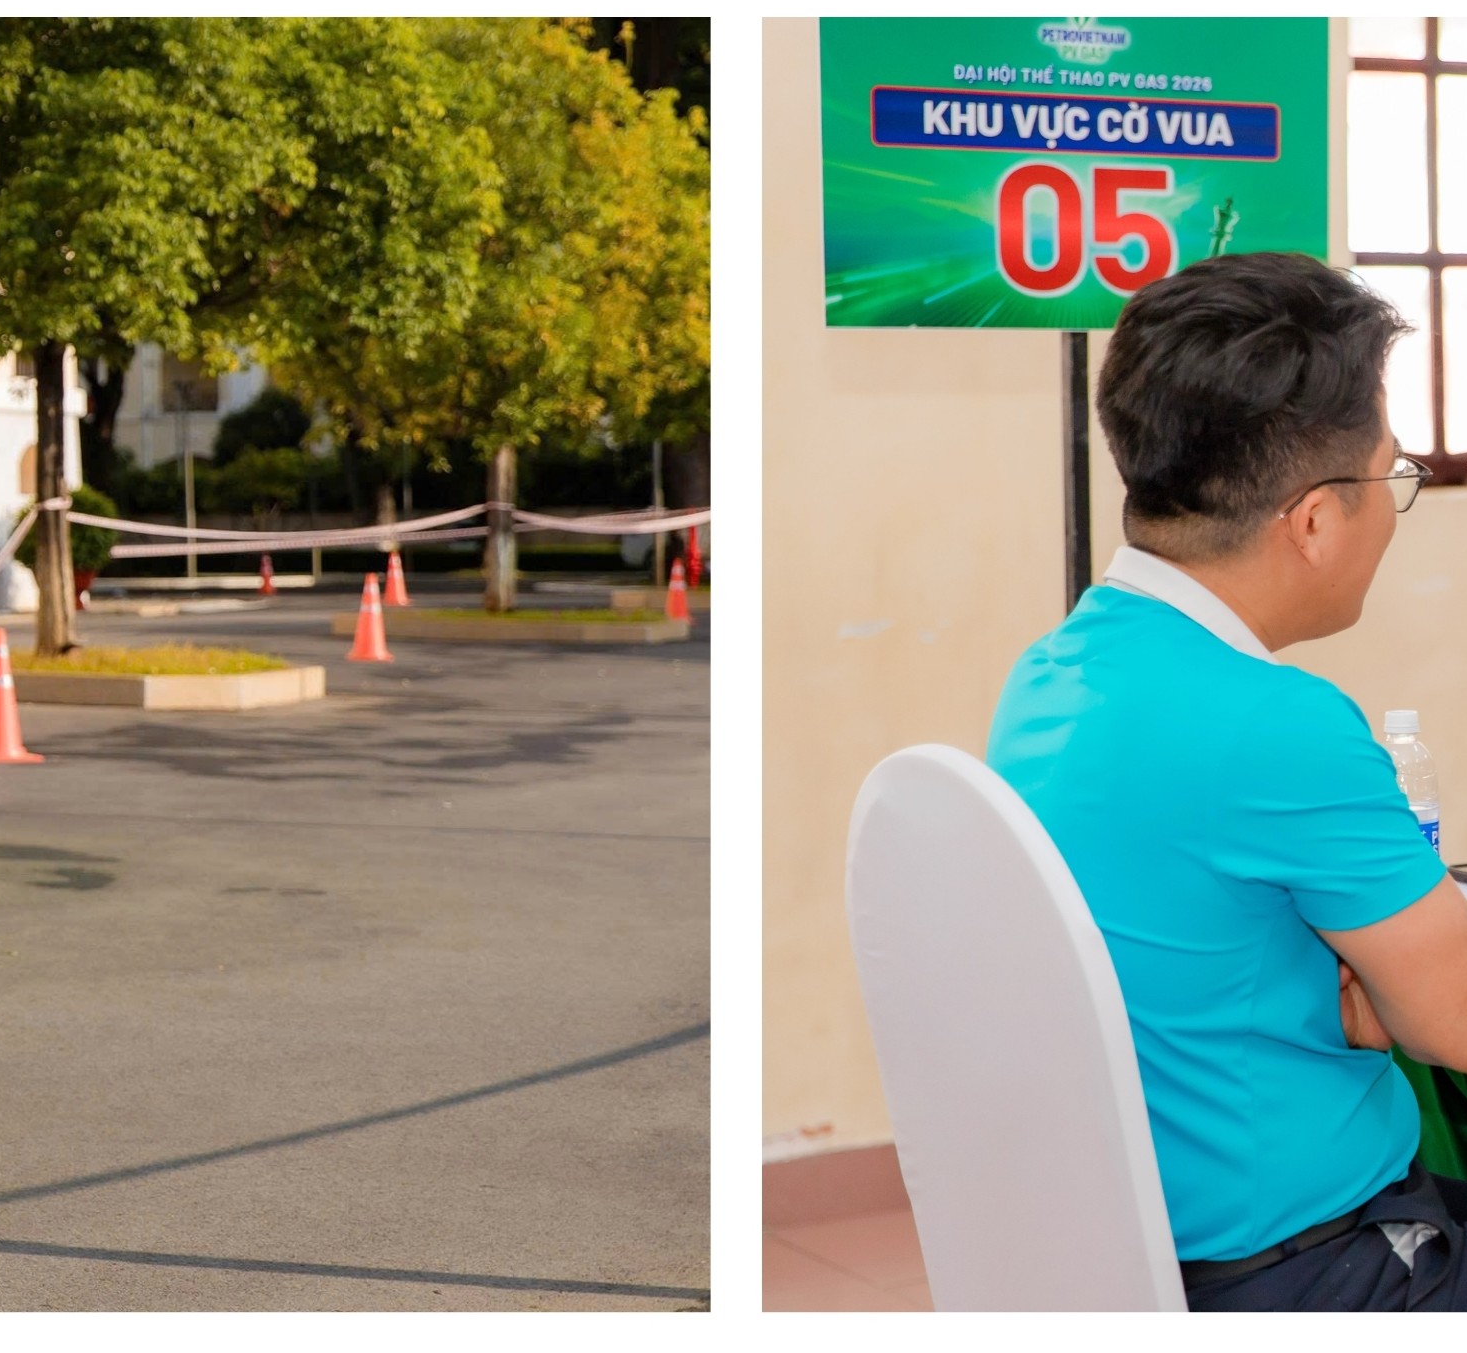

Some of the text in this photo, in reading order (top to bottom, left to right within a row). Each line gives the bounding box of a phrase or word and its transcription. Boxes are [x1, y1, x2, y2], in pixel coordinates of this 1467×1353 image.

[1040, 28, 1126, 44] PETROVIETNAM
[1058, 69, 1105, 87] THAO
[1108, 71, 1131, 88] PV
[1134, 73, 1168, 90] GAS
[1171, 75, 1213, 92] 2026
[923, 100, 1235, 150] KHU VỰC CỜ VUA
[997, 161, 1174, 294] 05
